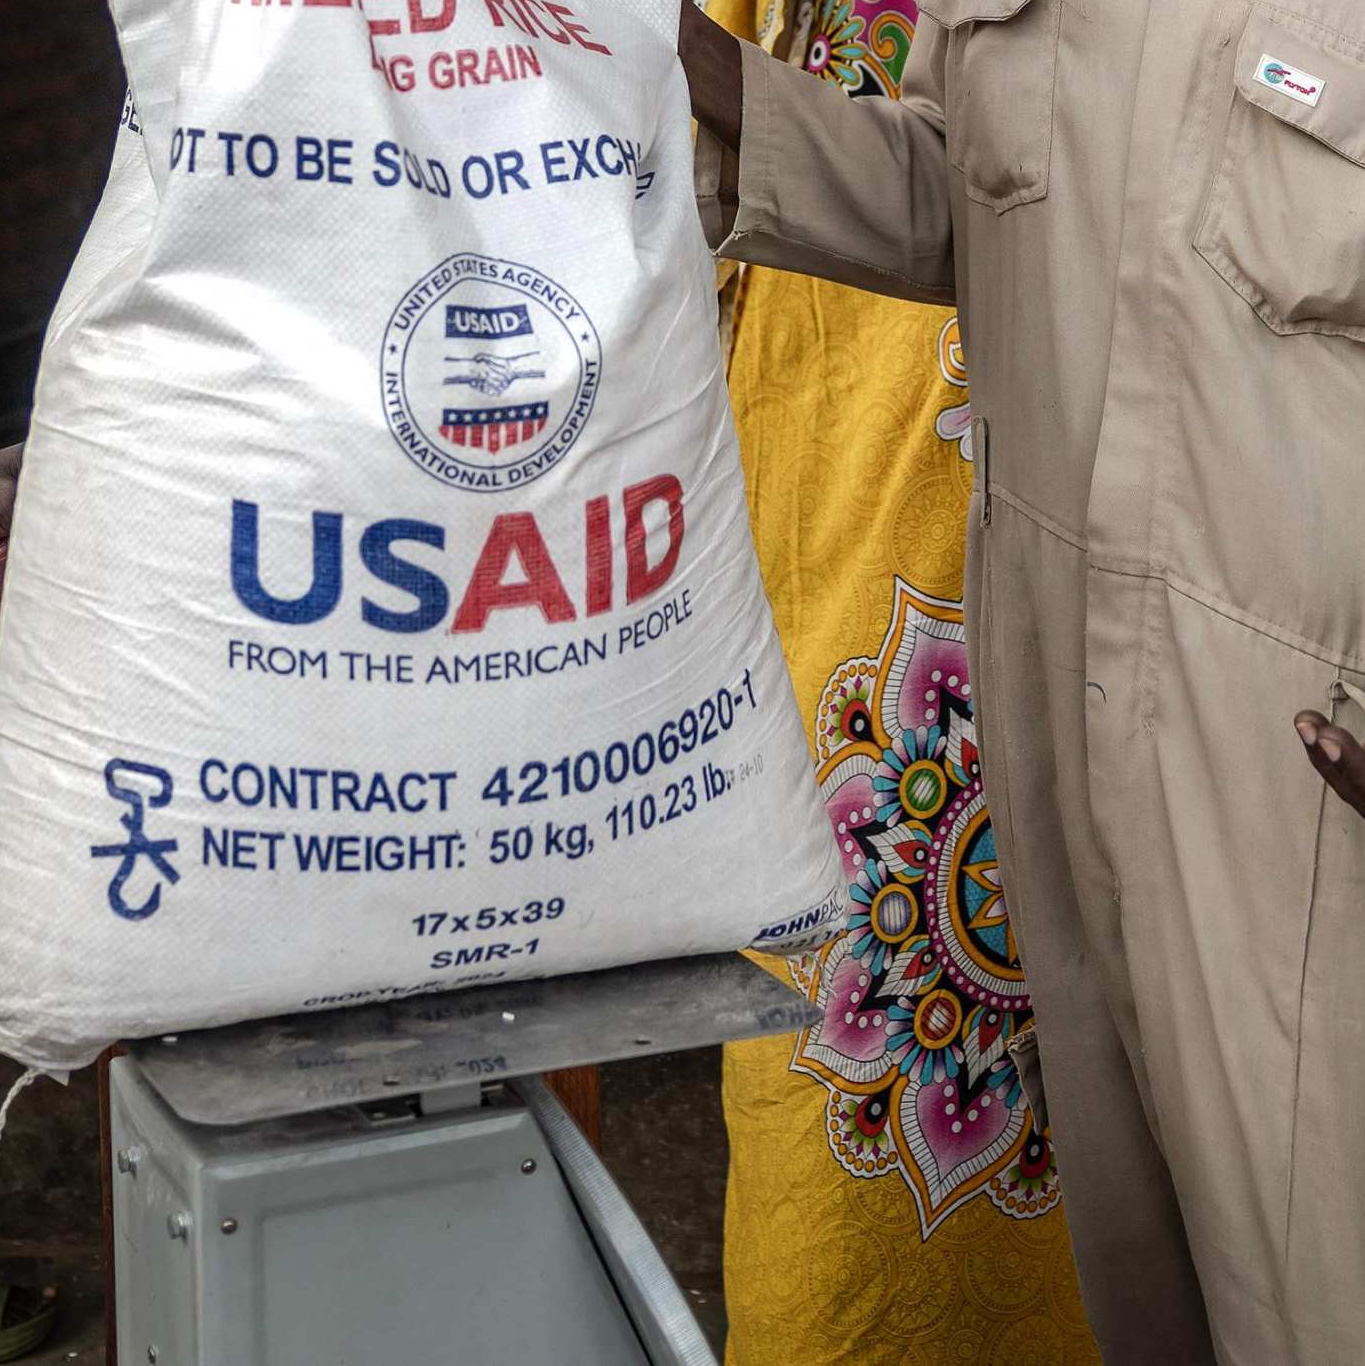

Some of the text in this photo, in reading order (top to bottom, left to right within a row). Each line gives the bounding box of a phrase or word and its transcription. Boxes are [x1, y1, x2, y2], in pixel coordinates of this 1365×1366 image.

[428, 45, 543, 91] GRAIN
[170, 127, 205, 173] OT
[217, 131, 278, 178] TO
[296, 136, 353, 184] BE
[372, 140, 451, 200] SOLD
[462, 149, 531, 200] OR
[394, 258, 581, 331] UNITED STATES AGENCY
[453, 310, 520, 333] USAID
[385, 359, 598, 487] INTERNATIONAL DEVELOPMENT
[230, 472, 685, 634] USAID
[228, 588, 694, 685] FROM THE AMERICAN PEOPLE
[198, 668, 758, 813] CONTRACT 4210006920-1
[201, 826, 296, 871] NET
[295, 831, 467, 872] WEIGHT:
[489, 822, 534, 862] 50
[543, 814, 595, 860] kg,
[604, 786, 698, 841] 110.23
[412, 897, 566, 937] 17x5x39
[430, 938, 540, 970] SMR-1
